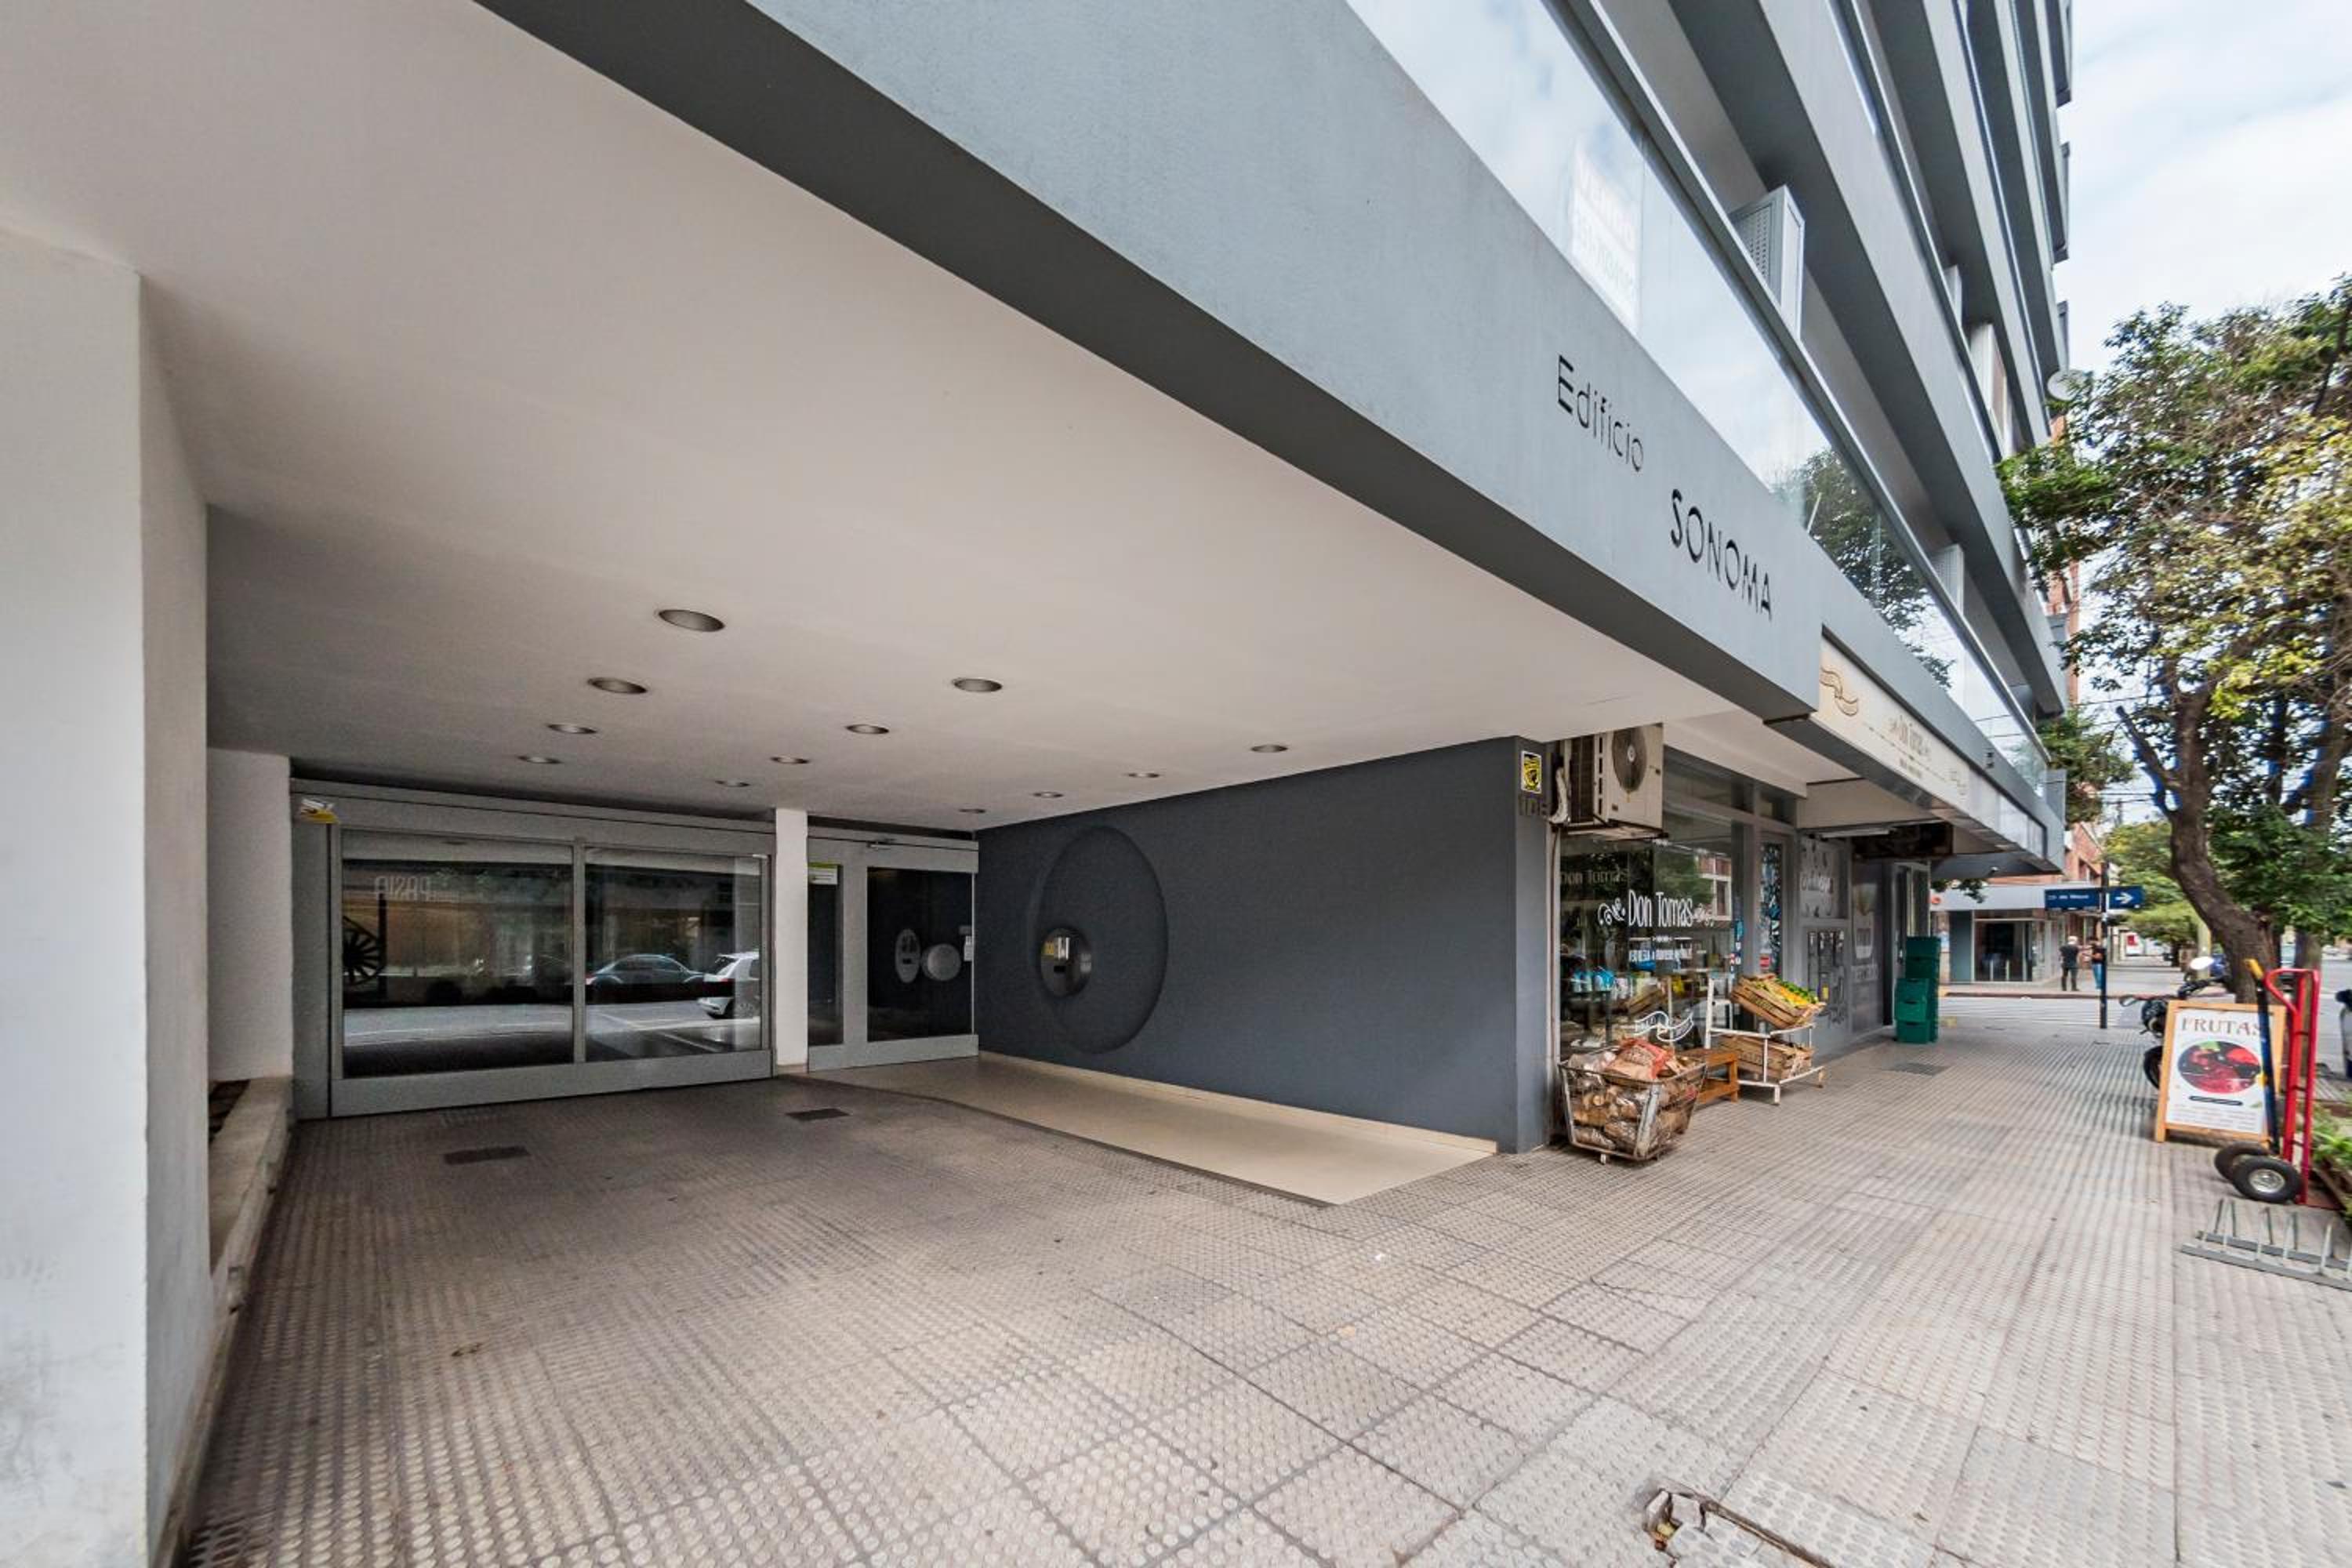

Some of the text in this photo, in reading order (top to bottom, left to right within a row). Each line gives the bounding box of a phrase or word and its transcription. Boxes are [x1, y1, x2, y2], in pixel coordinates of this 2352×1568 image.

[1557, 354, 1644, 473] Edificio
[1670, 488, 1773, 620] SONOMA
[1628, 889, 1693, 927] Don Tomas
[2182, 1017, 2262, 1036] FRUTAS
